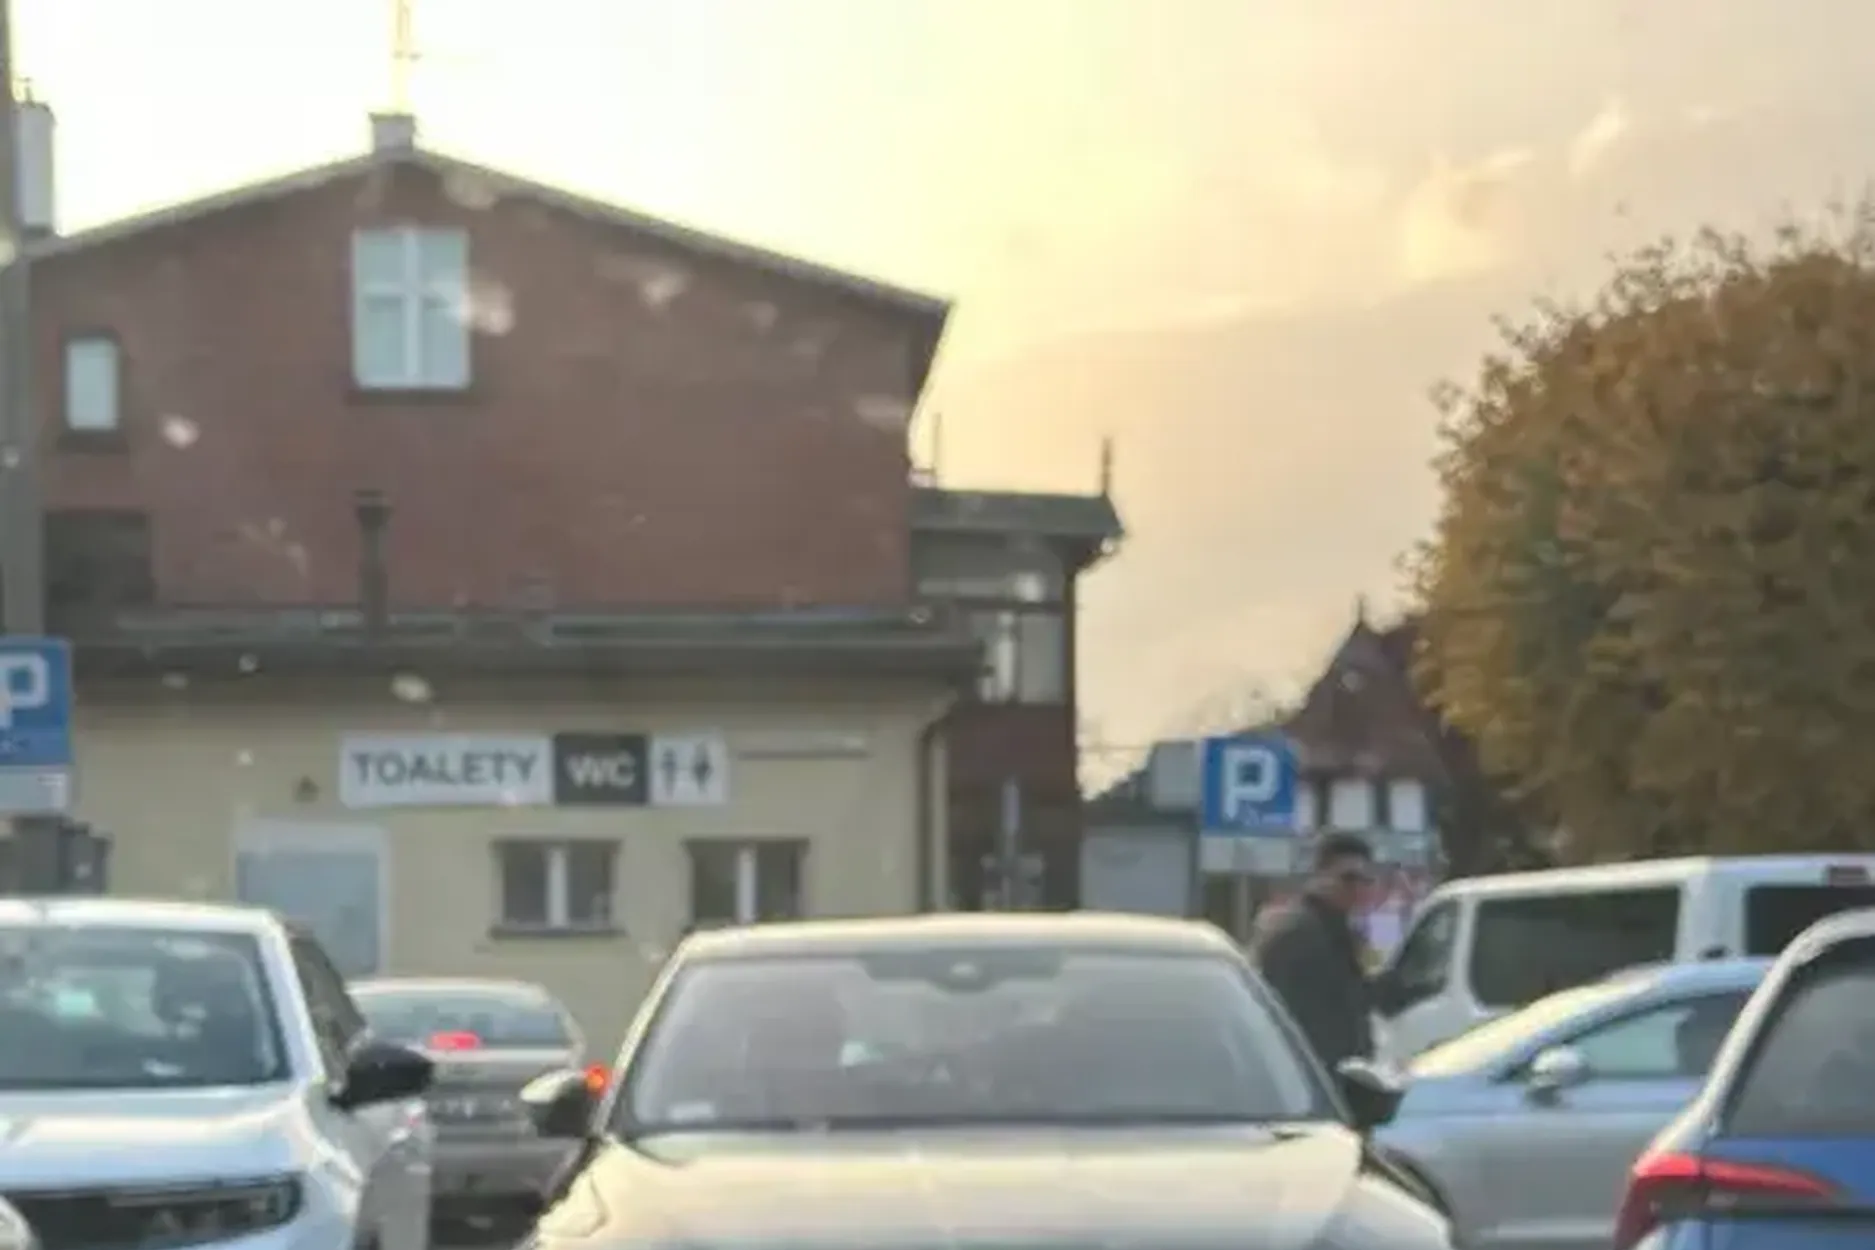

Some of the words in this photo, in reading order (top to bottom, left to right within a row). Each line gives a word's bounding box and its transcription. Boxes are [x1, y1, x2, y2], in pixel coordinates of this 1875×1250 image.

[350, 751, 537, 784] TOALETY
[566, 751, 636, 787] WC
[1222, 746, 1278, 819] P
